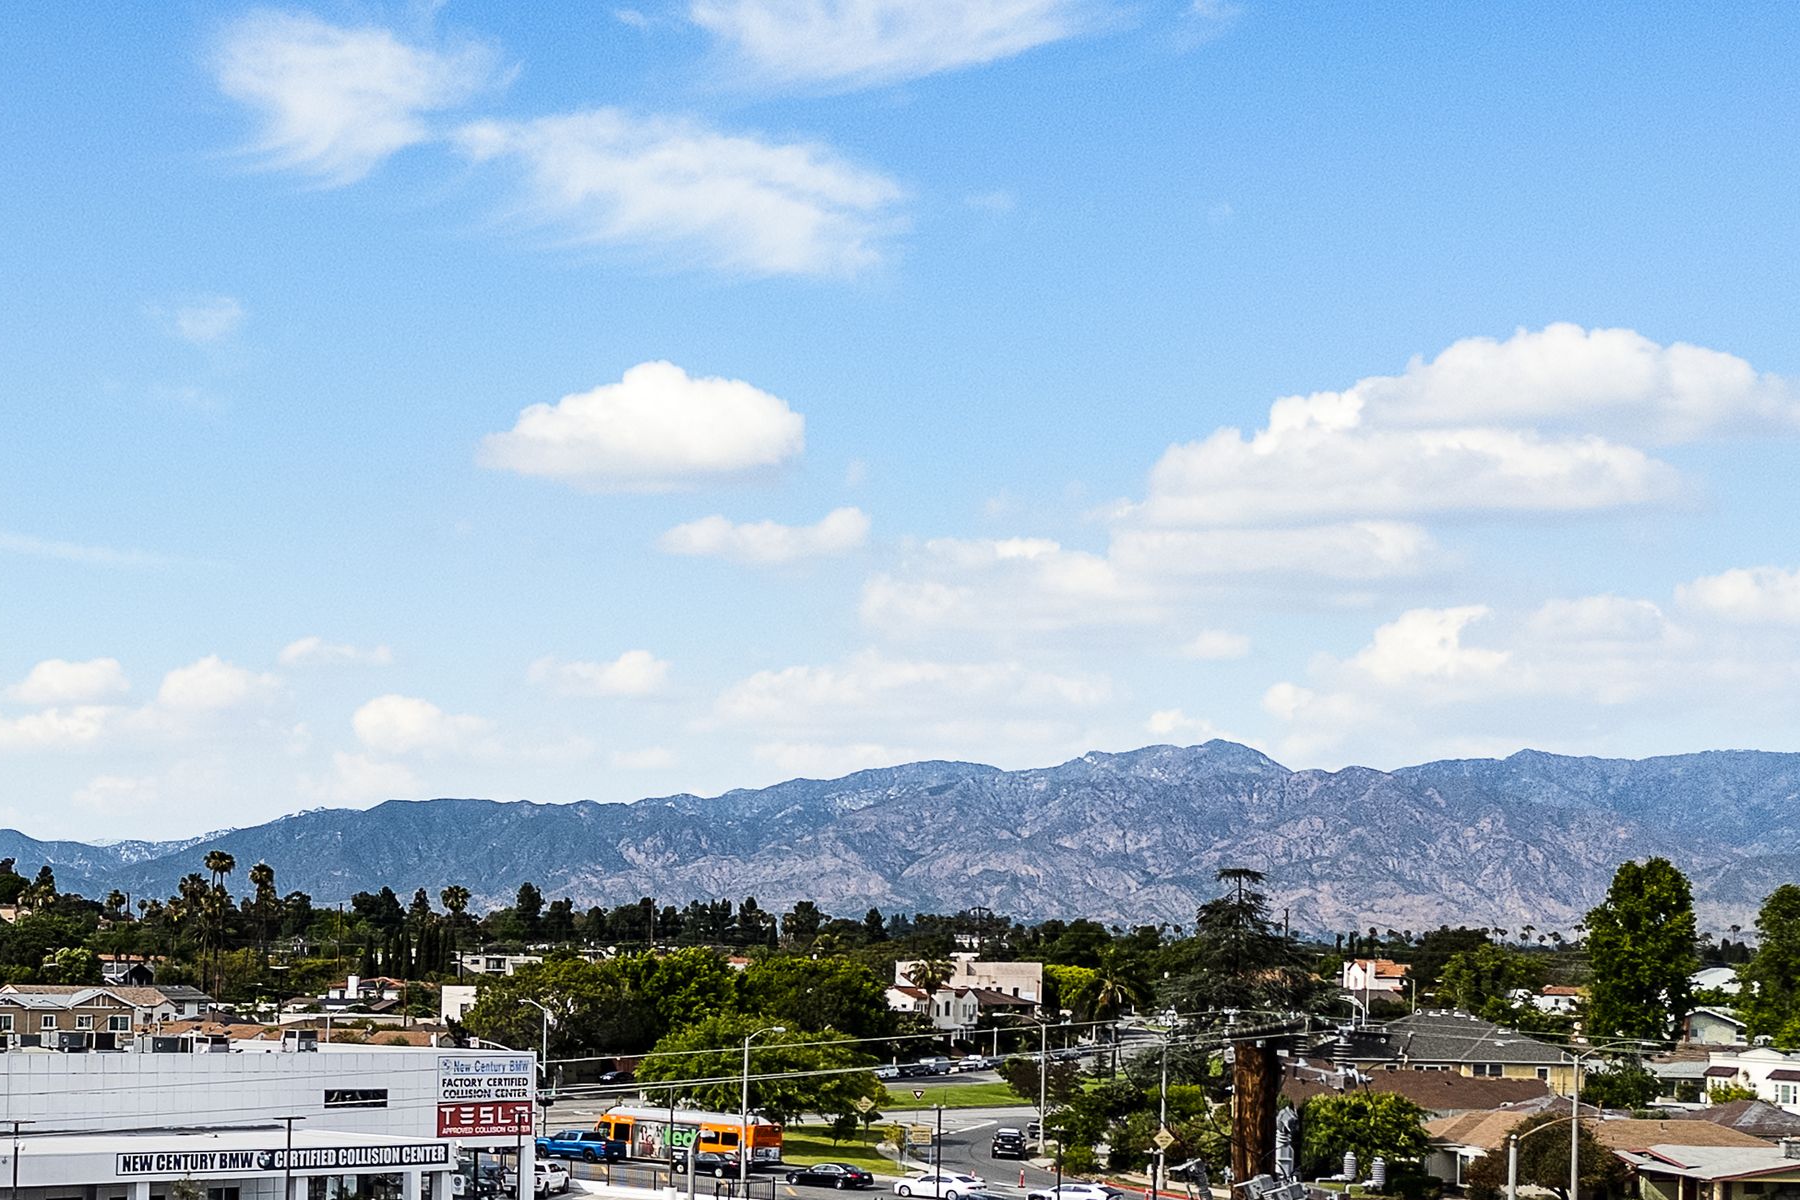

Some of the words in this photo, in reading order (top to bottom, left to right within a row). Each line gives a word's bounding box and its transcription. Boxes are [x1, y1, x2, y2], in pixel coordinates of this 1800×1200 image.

[454, 1061, 471, 1073] New
[474, 1060, 505, 1074] Century
[509, 1060, 529, 1072] BMW
[442, 1078, 483, 1087] FACTORY
[487, 1077, 529, 1087] CERTIFIED
[443, 1089, 491, 1099] COLLISION
[495, 1088, 527, 1098] CENTER
[440, 1106, 529, 1125] TESLA
[442, 1126, 473, 1134] APPROVED
[475, 1126, 506, 1134] COLLISION
[122, 1155, 153, 1172] NEW
[156, 1153, 216, 1171] CENTURY
[219, 1152, 254, 1169] BMW
[338, 1147, 399, 1165] COLLISION
[402, 1145, 445, 1163] CENTER
